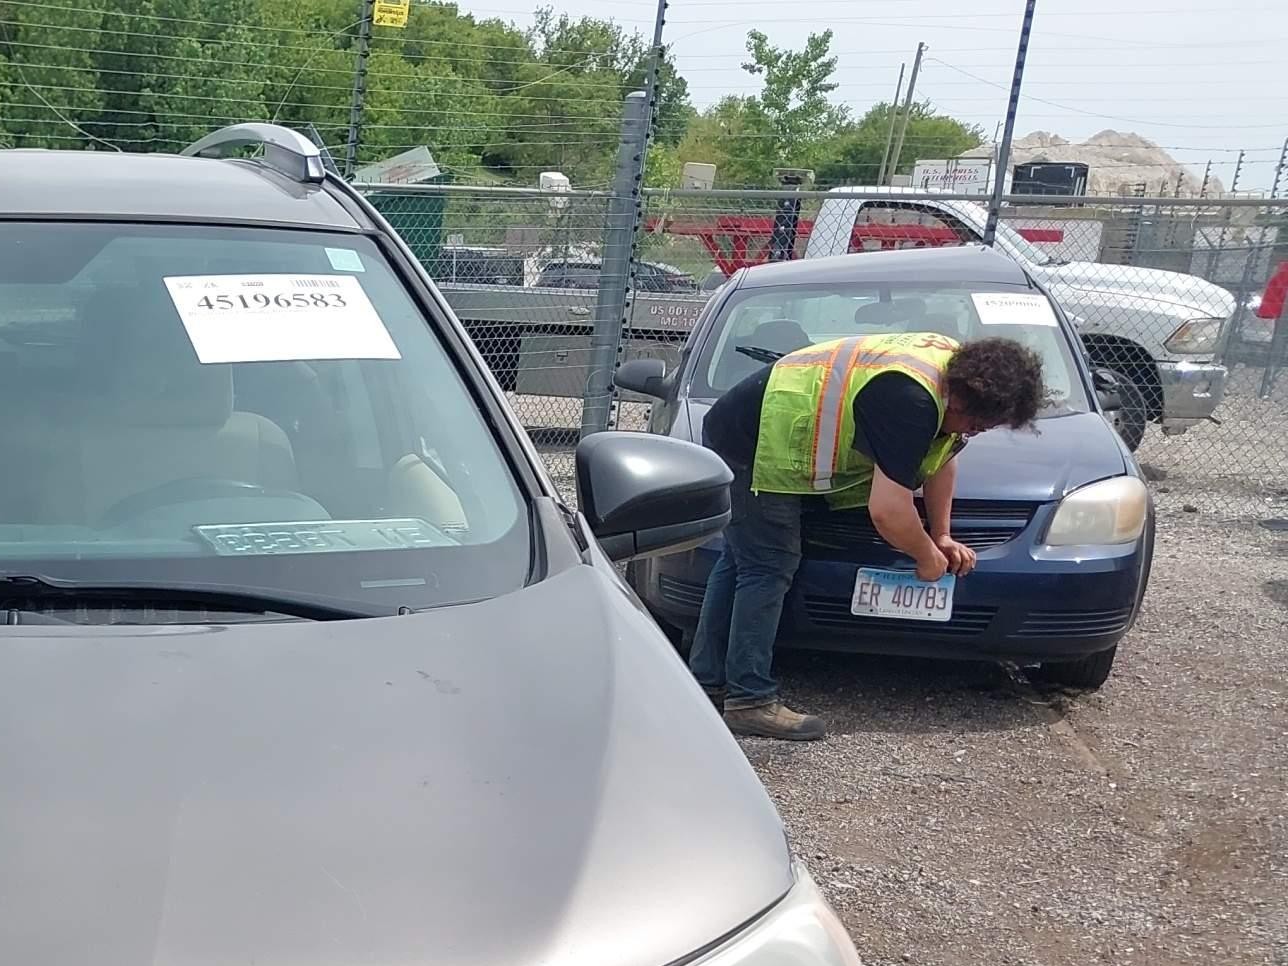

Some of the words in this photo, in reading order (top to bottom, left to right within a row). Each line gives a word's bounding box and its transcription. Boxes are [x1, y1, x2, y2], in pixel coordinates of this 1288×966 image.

[197, 292, 347, 310] 45196583
[650, 305, 664, 315] US
[858, 582, 882, 606] ER
[891, 585, 948, 610] 40783
